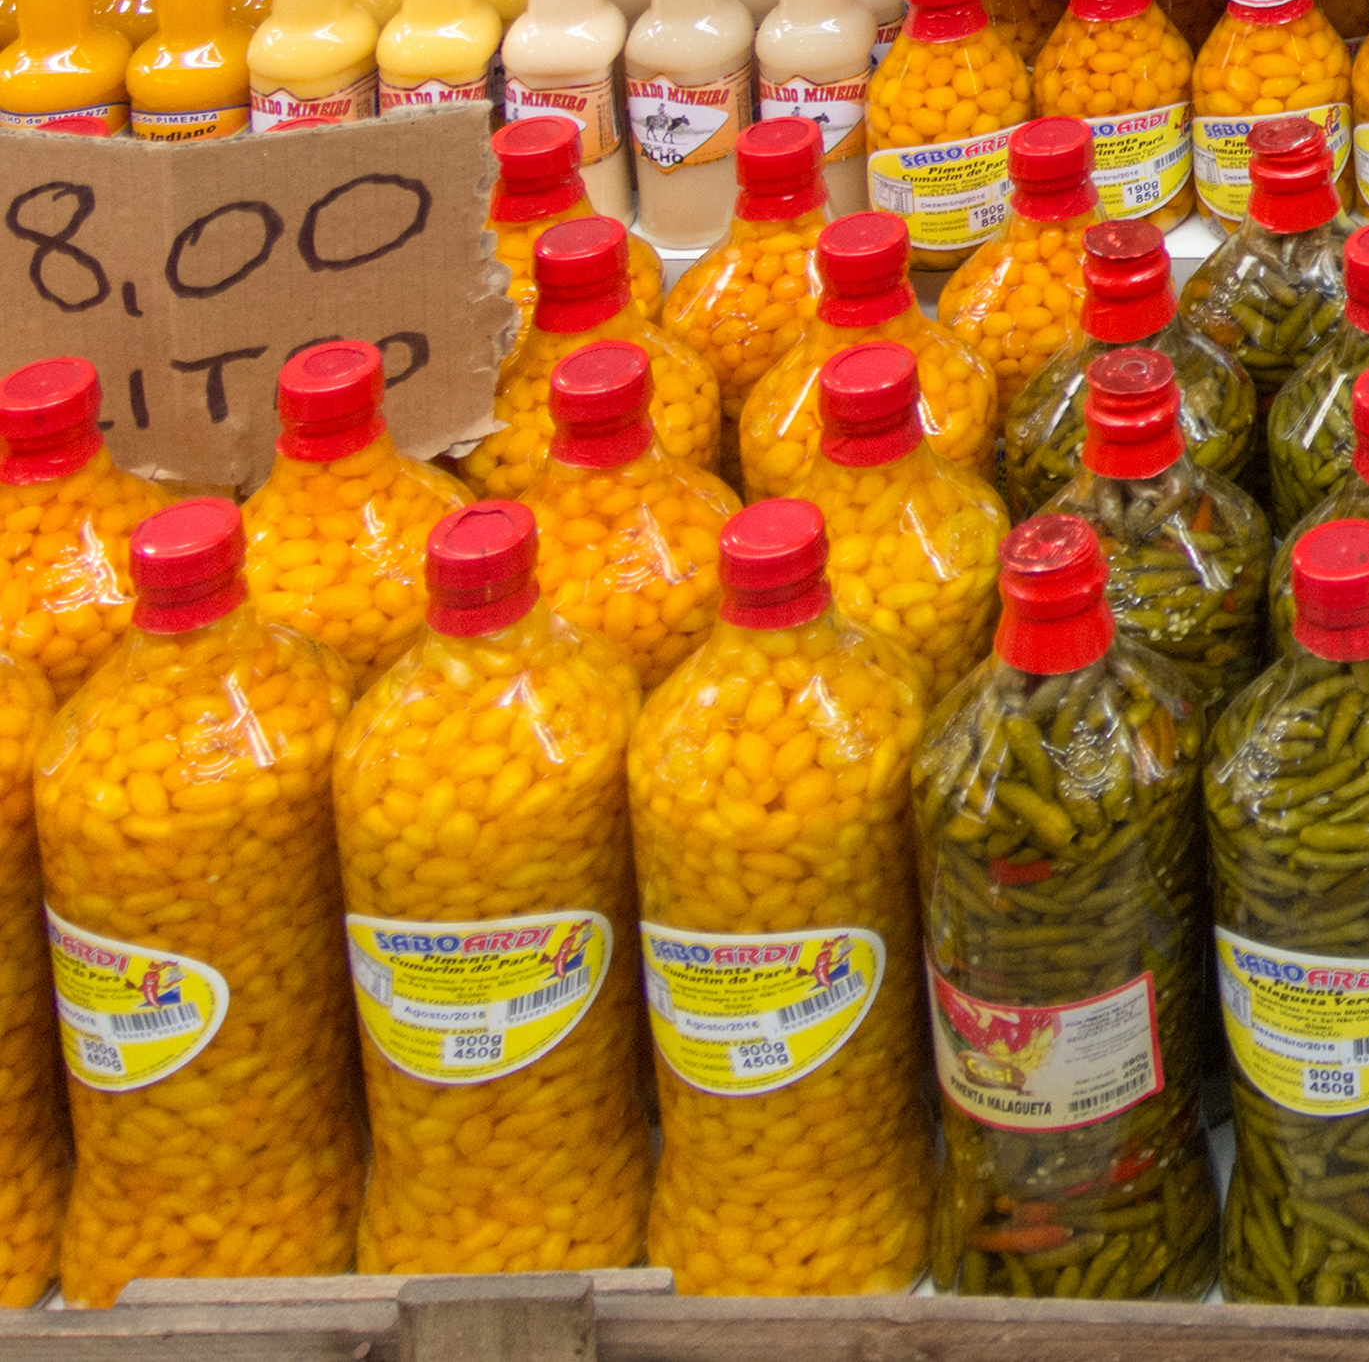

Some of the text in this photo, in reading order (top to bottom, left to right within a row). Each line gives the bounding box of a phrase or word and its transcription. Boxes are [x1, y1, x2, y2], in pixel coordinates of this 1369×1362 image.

[667, 89, 730, 104] MINEIRO
[804, 84, 867, 103] MINEIRO
[522, 92, 588, 112] MINEIRO
[155, 111, 218, 123] PIMENTA
[640, 150, 684, 165] ALHO
[7, 174, 431, 317] 8,00
[375, 925, 557, 955] SABOARDI
[455, 1033, 503, 1048] 900g
[453, 1046, 502, 1060] 450g
[738, 1041, 786, 1058] 900g
[742, 1053, 790, 1070] 450g
[965, 1054, 1014, 1085] Casi
[1308, 1068, 1355, 1083] 900g
[1308, 1081, 1355, 1096] 450g
